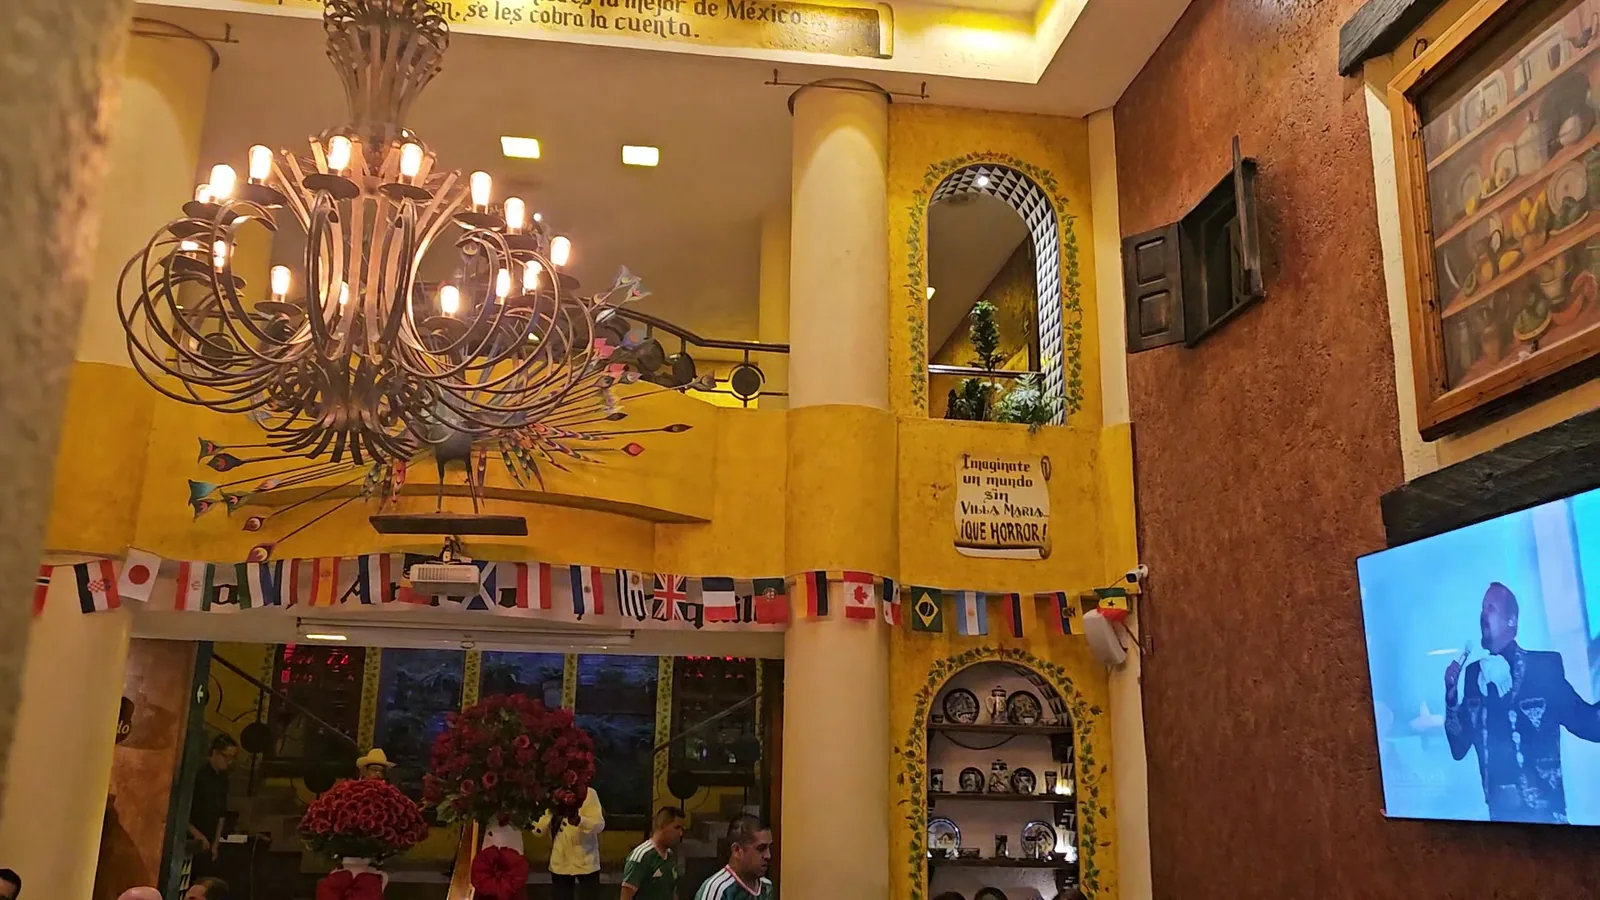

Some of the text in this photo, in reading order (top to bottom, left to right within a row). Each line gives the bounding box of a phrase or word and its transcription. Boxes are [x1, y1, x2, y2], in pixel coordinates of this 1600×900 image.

[694, 0, 719, 17] de
[463, 2, 488, 21] se
[495, 5, 524, 25] les
[530, 6, 584, 27] cobra
[591, 9, 609, 29] la
[614, 15, 700, 39] cuenta.
[963, 475, 1033, 488] un mundo
[983, 489, 1009, 503] sin
